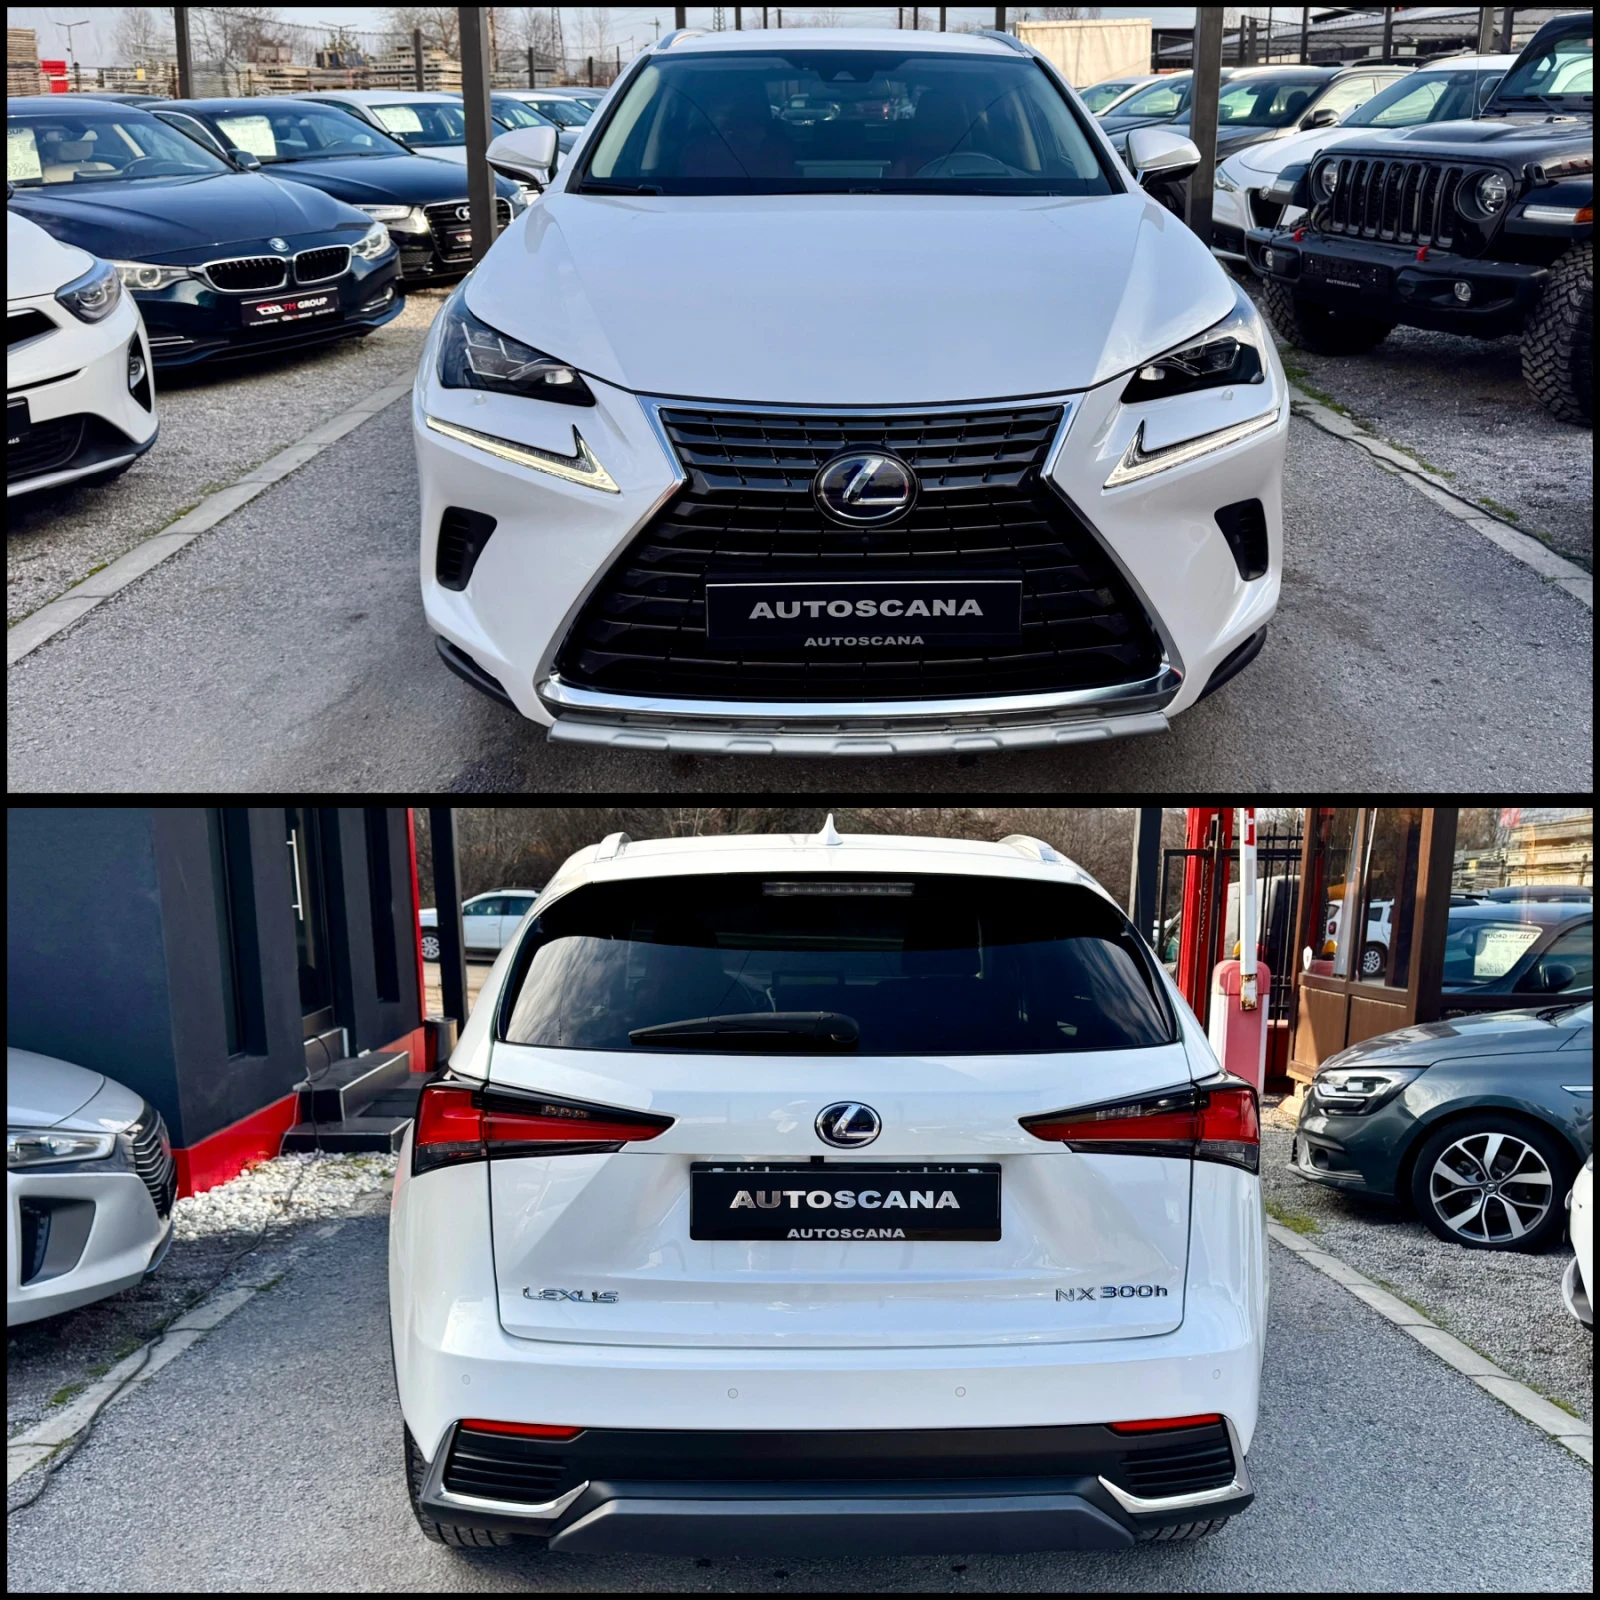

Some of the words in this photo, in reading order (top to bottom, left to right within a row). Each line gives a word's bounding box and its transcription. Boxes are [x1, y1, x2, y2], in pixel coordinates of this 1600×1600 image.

[283, 303, 296, 311] TM
[297, 297, 328, 309] GROUP
[748, 599, 984, 620] AUTOSCANA
[804, 636, 925, 647] AUTOSCANA
[729, 1190, 961, 1209] AUTOSCANA
[787, 1228, 906, 1239] AUTOSCANA
[522, 1286, 620, 1304] LEXUS
[1055, 1286, 1096, 1302] NX
[1099, 1284, 1169, 1299] 300h
